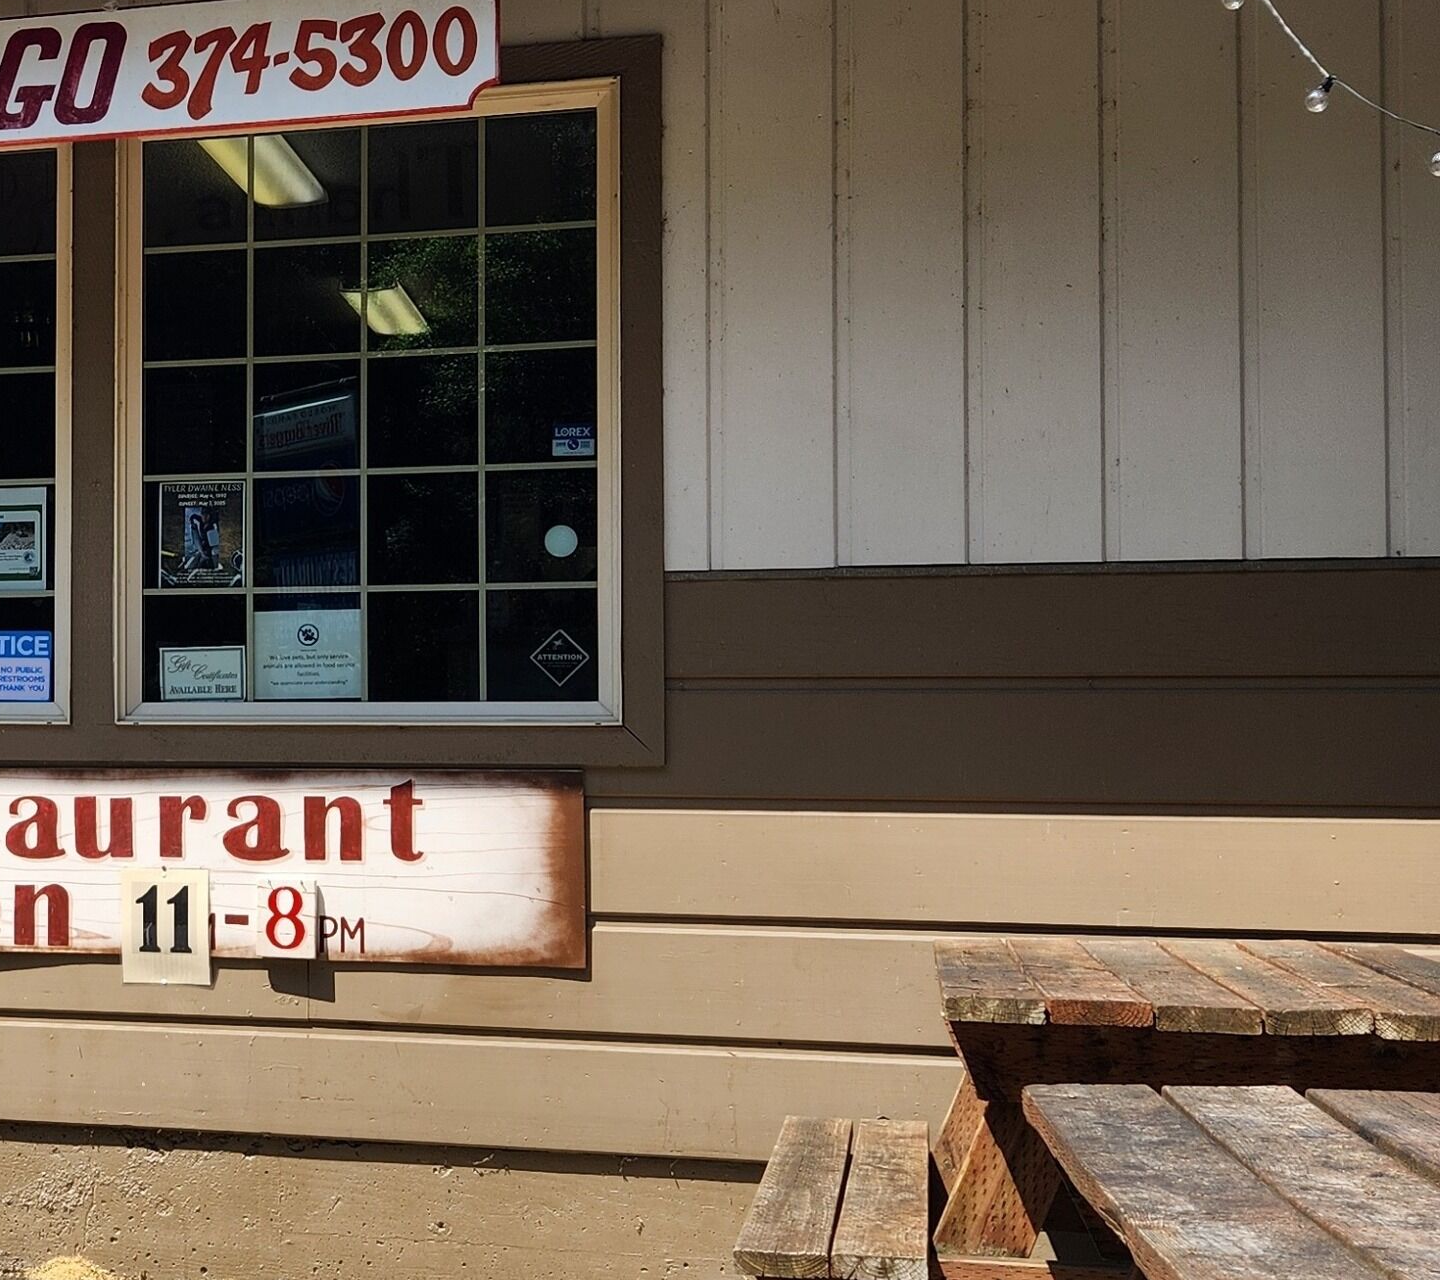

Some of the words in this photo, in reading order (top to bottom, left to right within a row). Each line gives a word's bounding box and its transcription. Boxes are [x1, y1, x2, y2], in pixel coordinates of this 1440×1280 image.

[141, 6, 478, 120] 374-5300
[555, 427, 590, 437] LOREX
[187, 484, 219, 492] DWAINE
[221, 483, 242, 491] NESS
[15, 666, 43, 674] PUBLIC
[167, 655, 191, 673] Gift
[191, 664, 237, 682] Certificates
